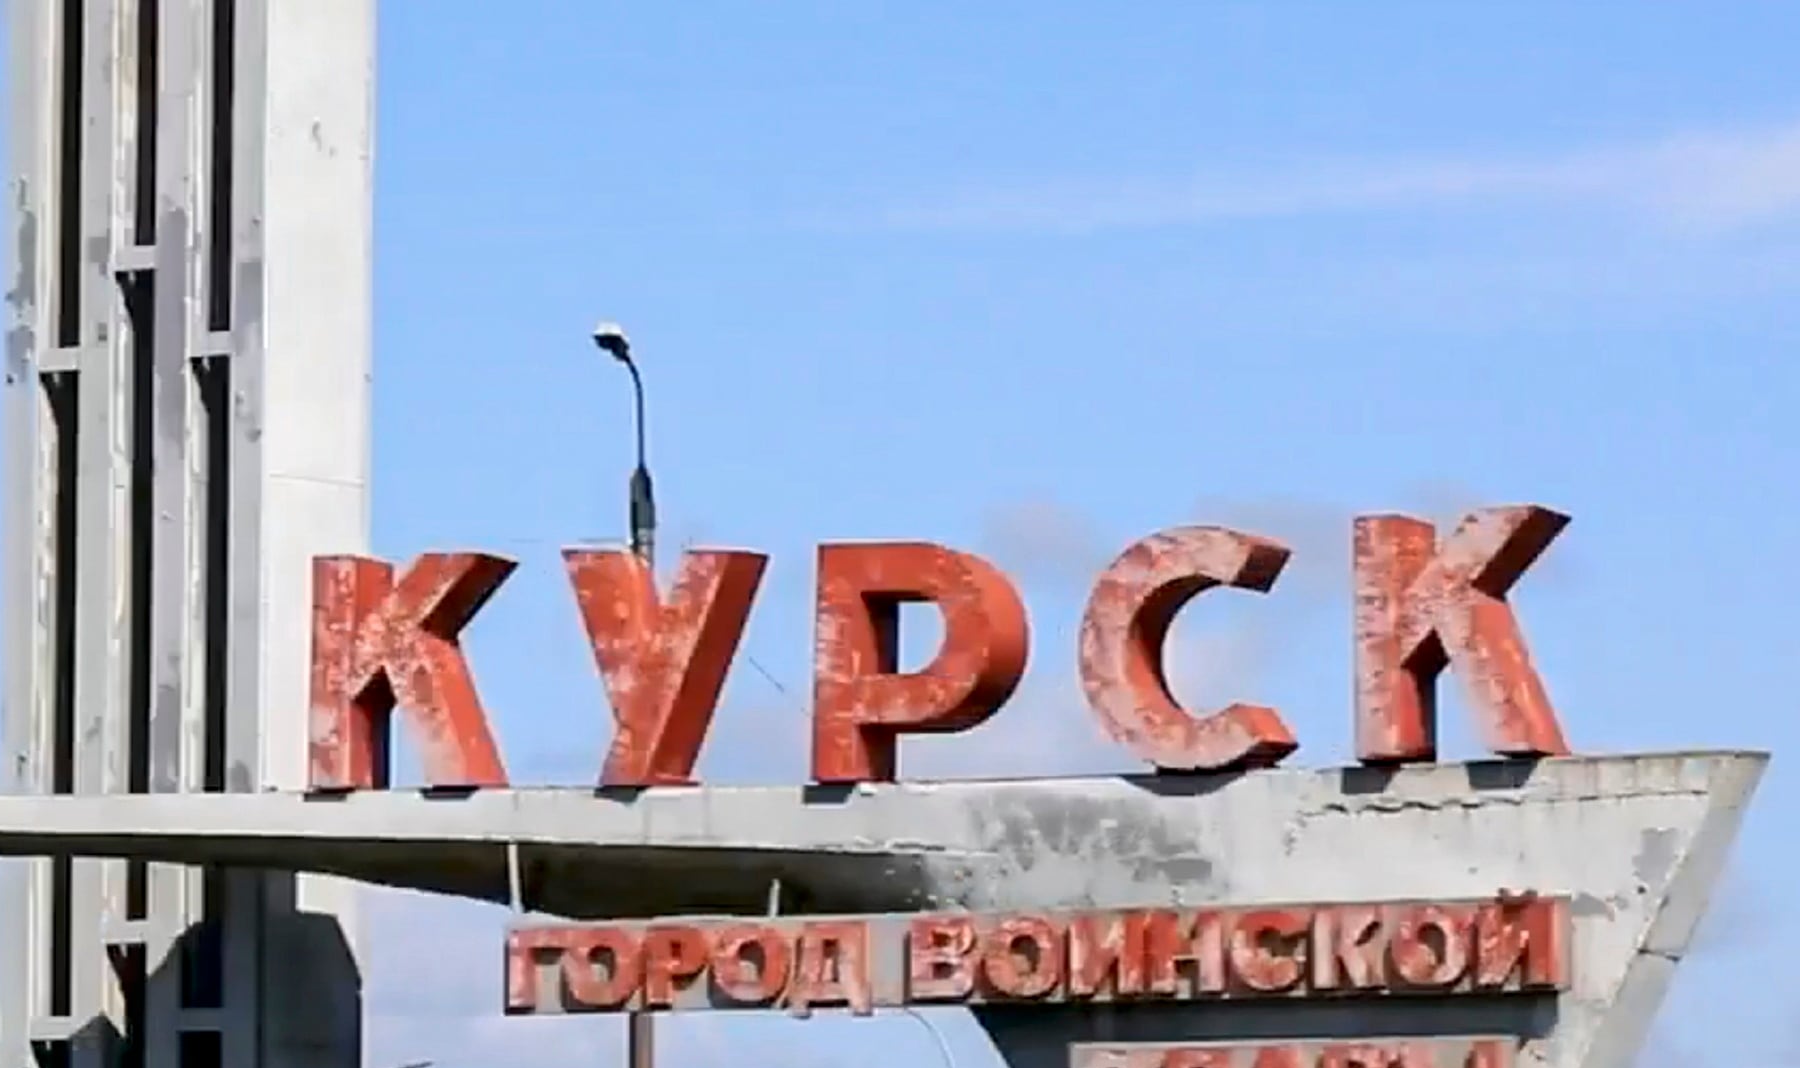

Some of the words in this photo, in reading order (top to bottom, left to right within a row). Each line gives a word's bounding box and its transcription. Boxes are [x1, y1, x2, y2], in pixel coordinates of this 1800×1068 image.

[309, 505, 1571, 791] КУРСК
[508, 921, 873, 1017] ГОРОД
[906, 888, 1562, 999] ВОИНСКОЙ
